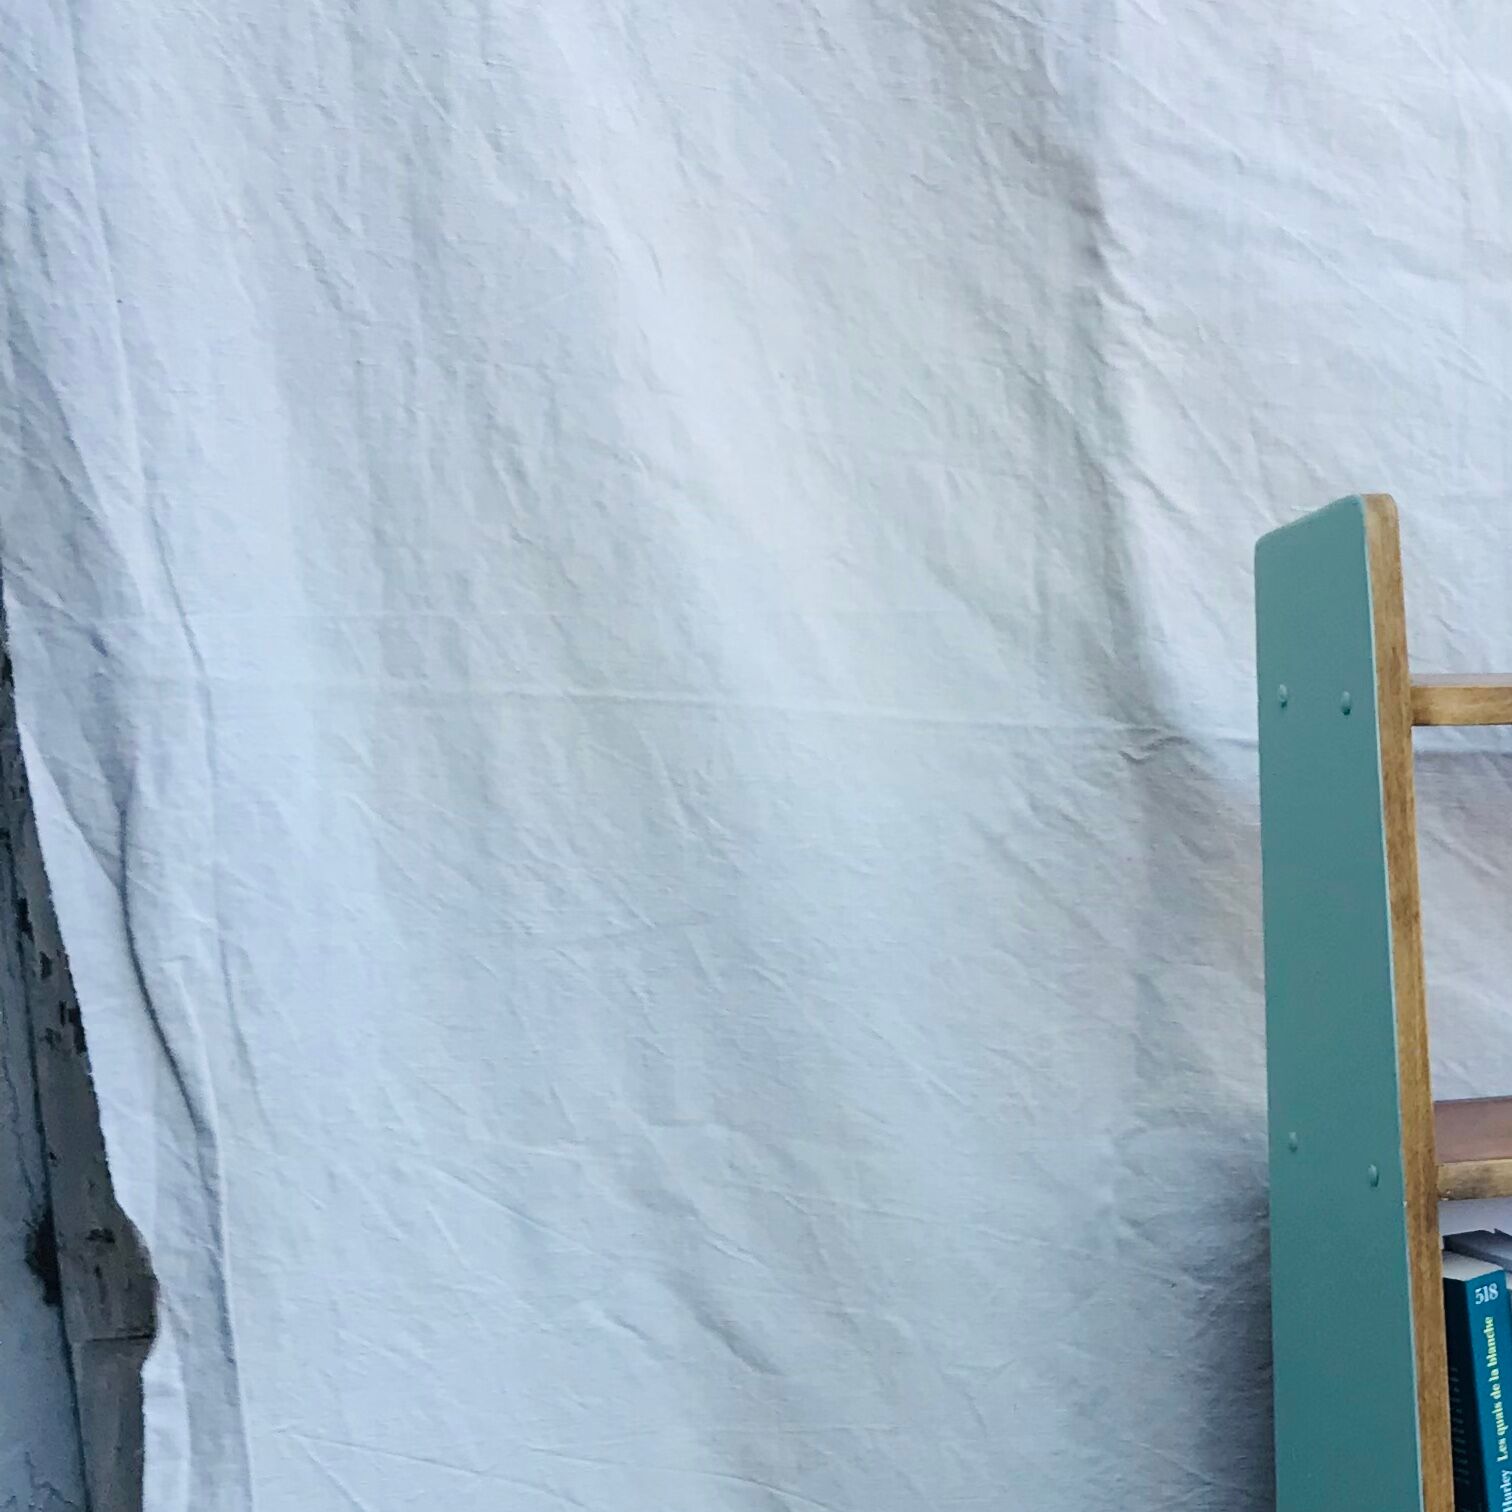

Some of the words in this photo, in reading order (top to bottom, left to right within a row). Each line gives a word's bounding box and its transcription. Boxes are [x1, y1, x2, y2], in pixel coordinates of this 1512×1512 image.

[1474, 1282, 1499, 1305] 518
[1484, 1316, 1498, 1368] blanche
[1488, 1369, 1499, 1382] la
[1490, 1384, 1501, 1399] de
[1491, 1401, 1509, 1436] quais
[1496, 1437, 1509, 1462] Les
